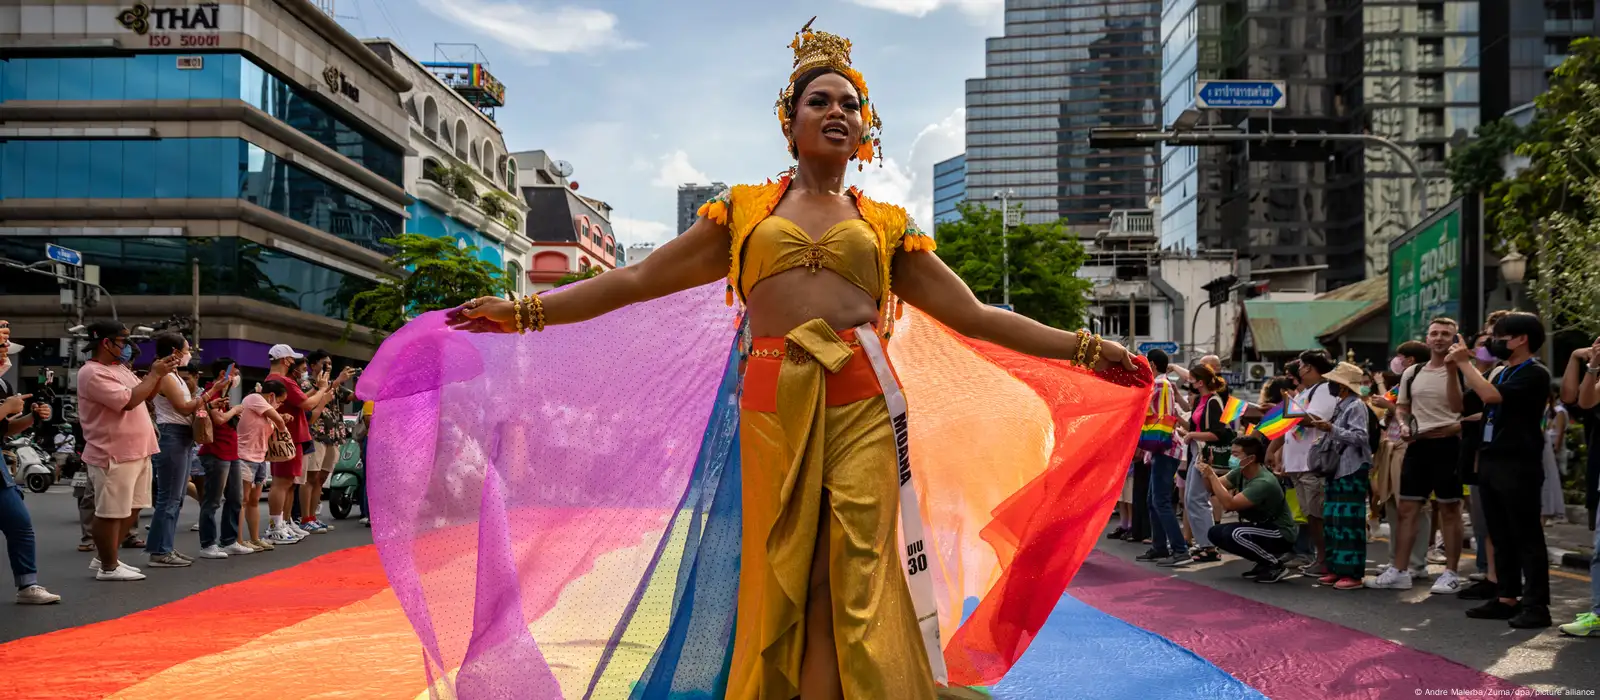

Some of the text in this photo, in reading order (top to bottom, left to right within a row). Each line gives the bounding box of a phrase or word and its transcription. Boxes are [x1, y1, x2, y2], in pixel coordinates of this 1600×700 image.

[150, 8, 219, 29] THAI
[149, 35, 171, 46] ISO
[893, 411, 912, 487] MOANA
[908, 553, 928, 576] 30
